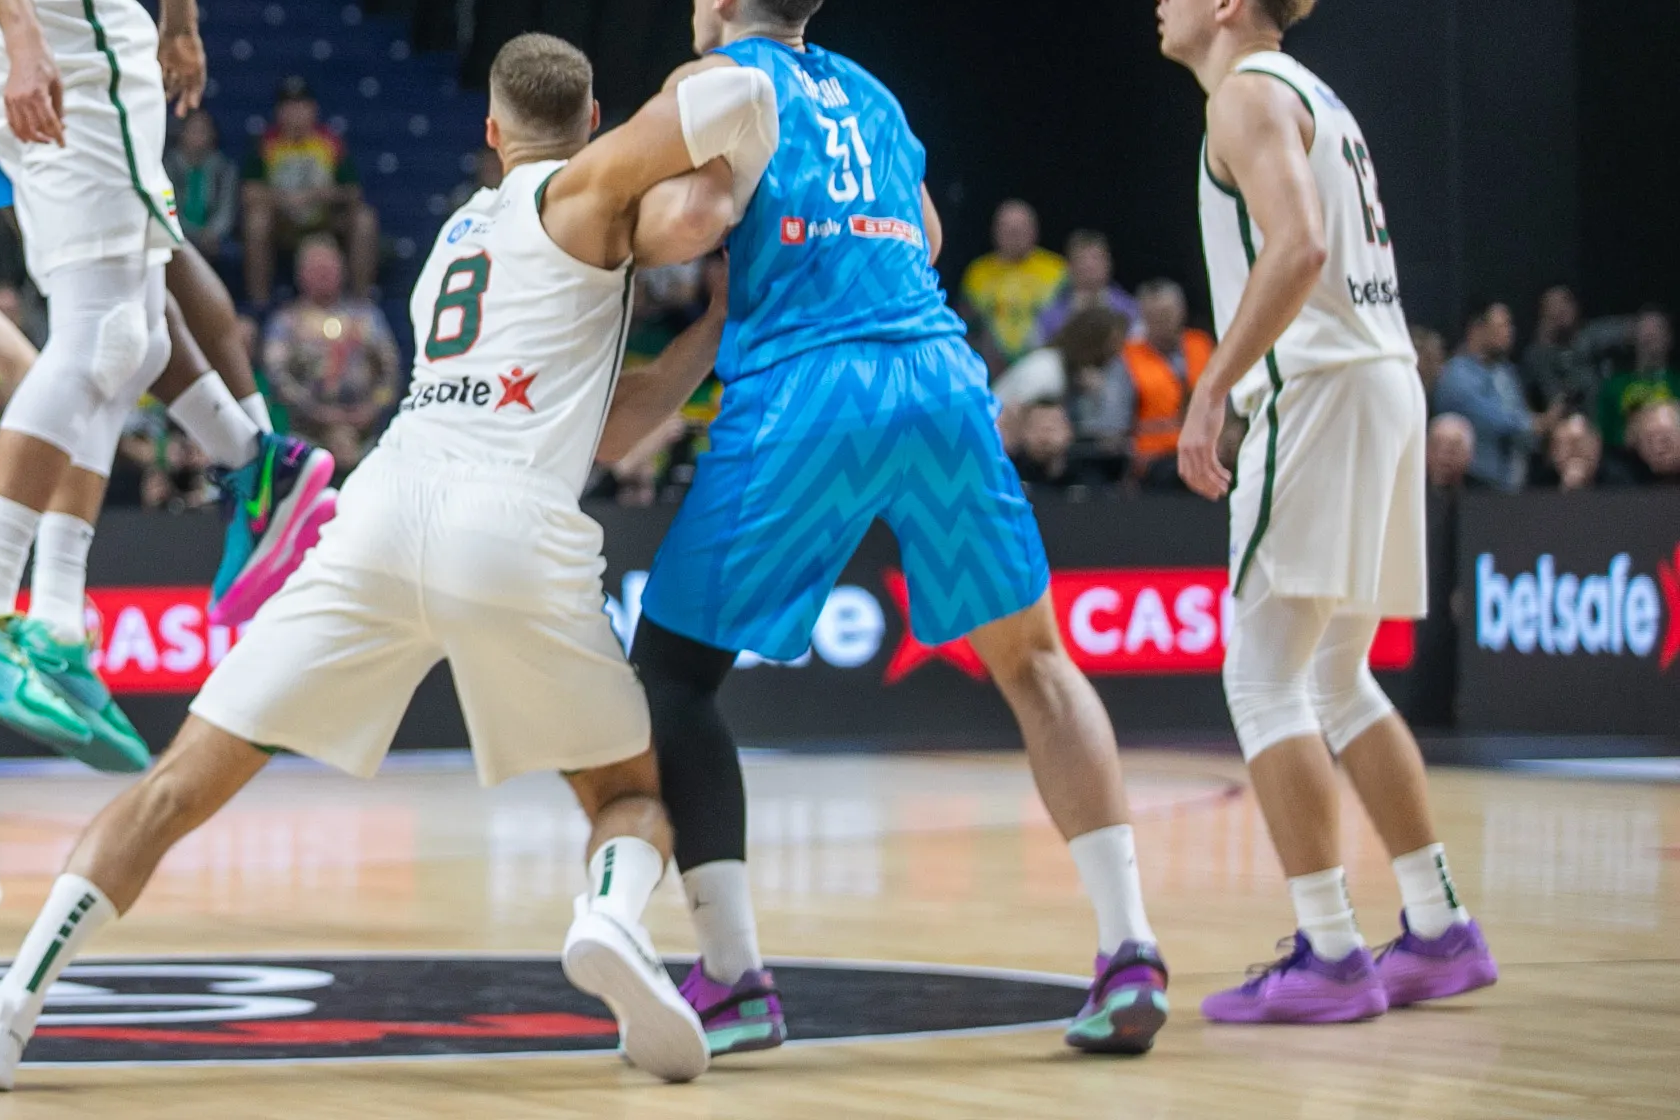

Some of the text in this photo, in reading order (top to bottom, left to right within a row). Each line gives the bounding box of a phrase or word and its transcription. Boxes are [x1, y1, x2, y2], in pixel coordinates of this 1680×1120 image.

[815, 111, 877, 204] 31
[424, 249, 492, 363] 8
[1475, 551, 1662, 658] betsafe
